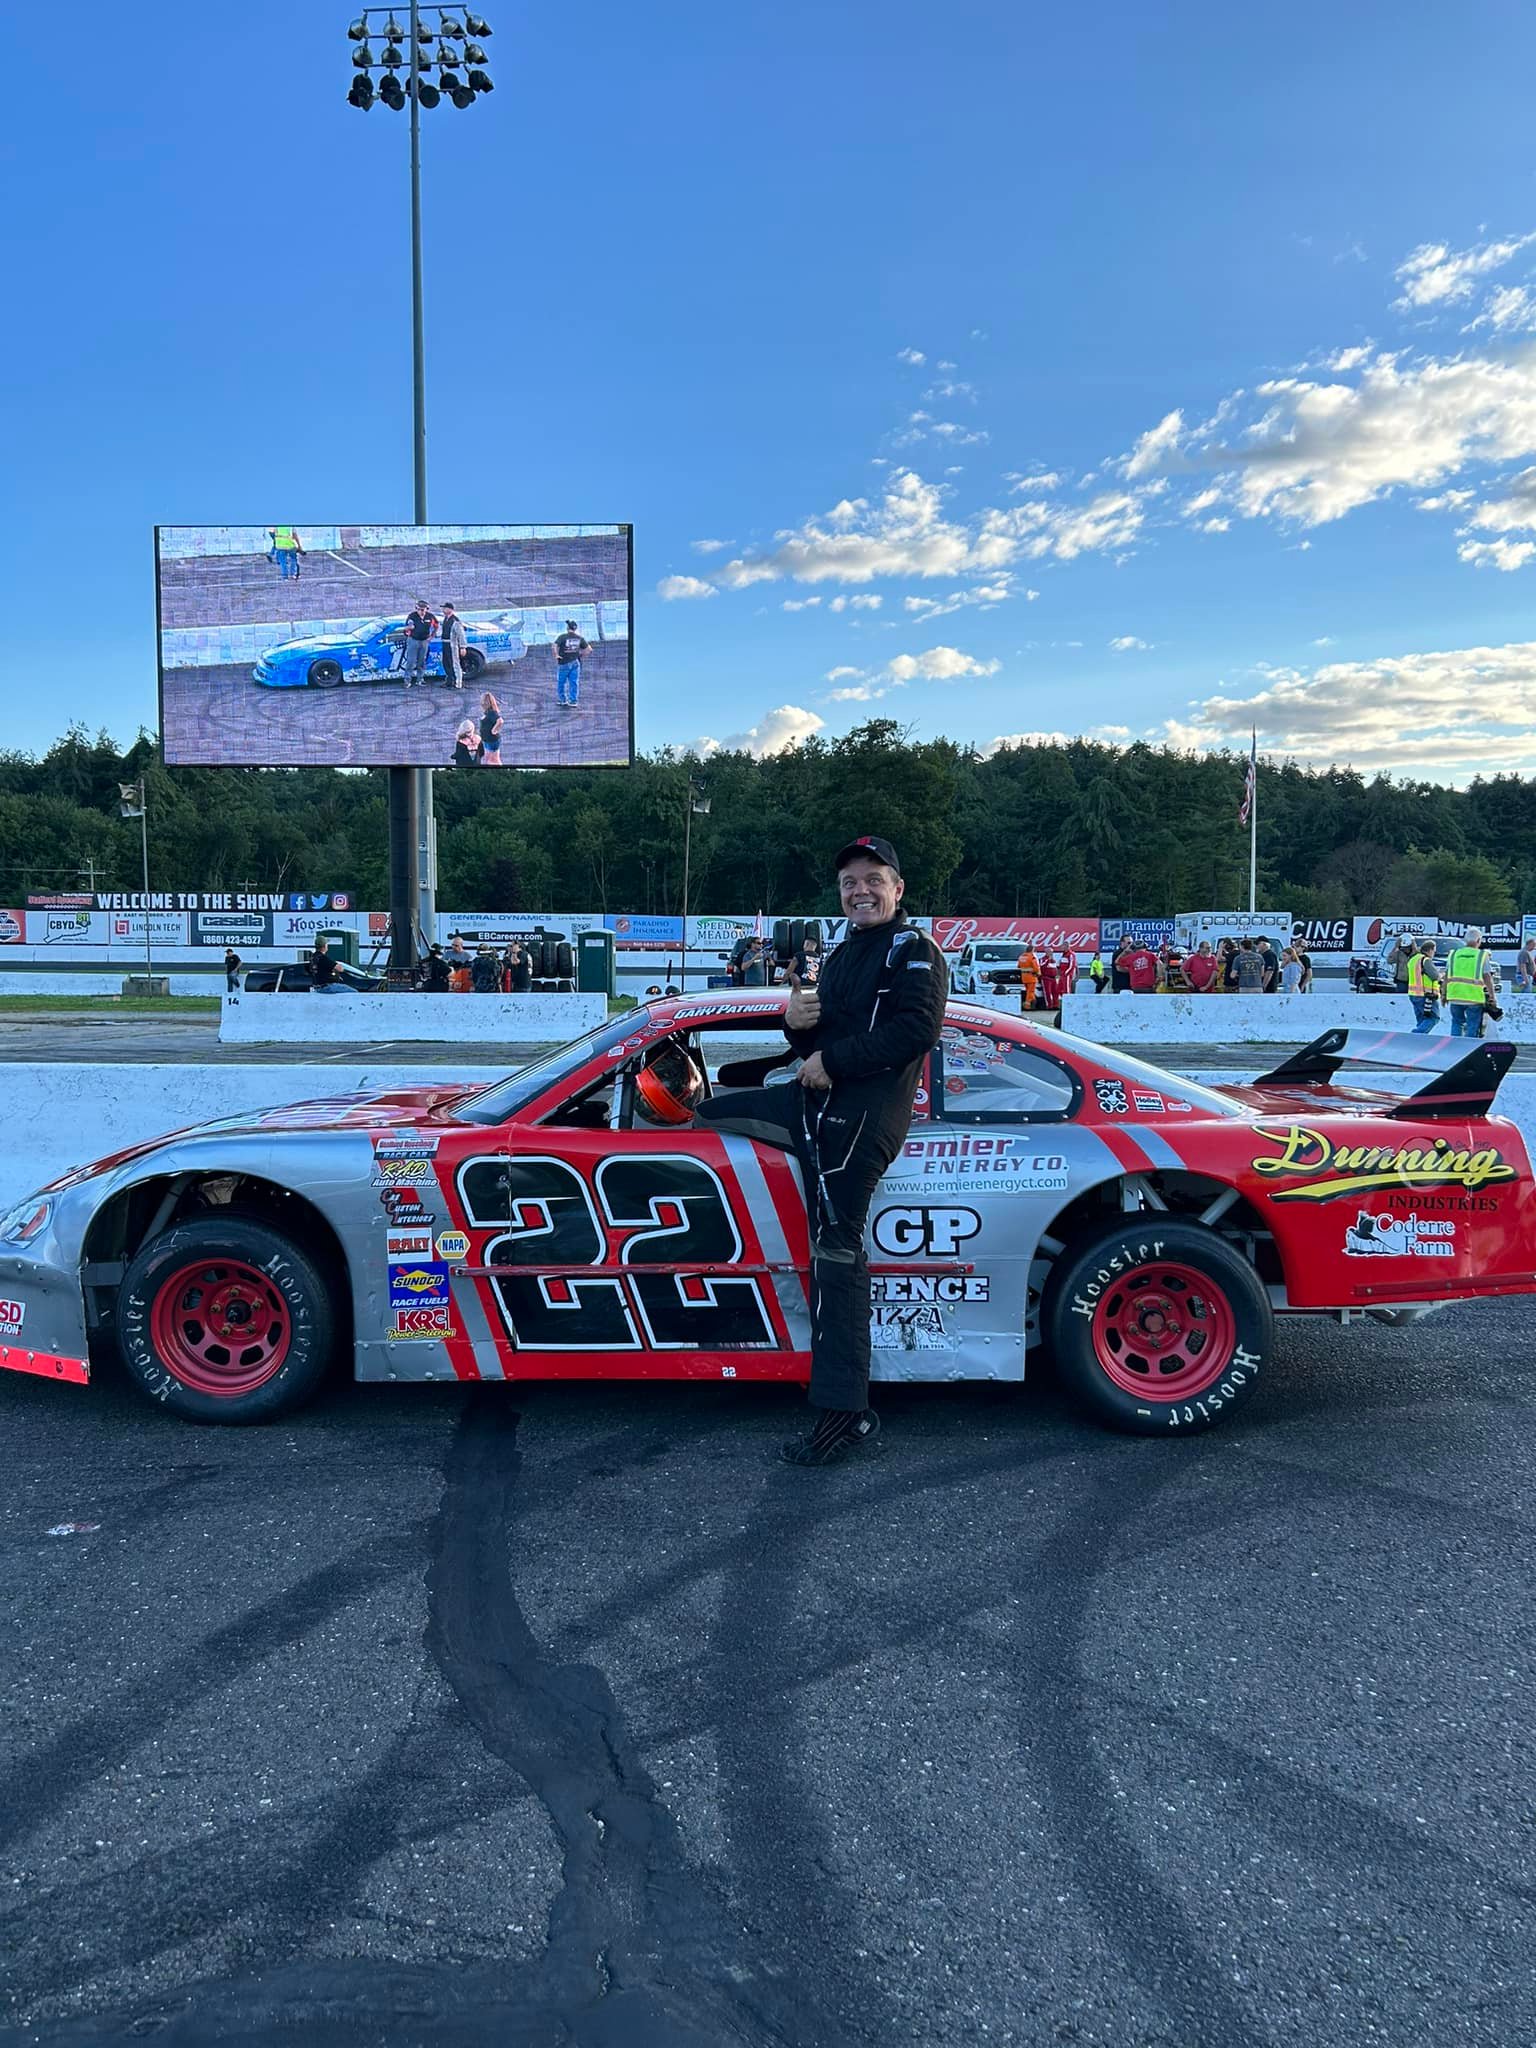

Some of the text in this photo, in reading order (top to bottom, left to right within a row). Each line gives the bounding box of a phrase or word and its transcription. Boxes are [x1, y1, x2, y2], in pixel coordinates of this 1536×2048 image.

[97, 893, 285, 910] WELCOME TO THE SHOW
[49, 920, 75, 930] CBYD
[132, 923, 161, 931] LINCOLN
[286, 916, 344, 933] Hoosier
[1124, 920, 1174, 931] Trantolo
[1292, 920, 1348, 940] CING
[1381, 922, 1425, 939] METRO
[478, 932, 542, 941] EBCareers.com
[935, 919, 1097, 949] Budweiser
[1132, 931, 1175, 941] Trantol
[1306, 940, 1345, 949] PARTNER
[902, 1135, 1011, 1157] emier
[923, 1156, 1069, 1174] ENERGY CO.
[1251, 1124, 1519, 1195] Dunning
[372, 1177, 438, 1187] Auto Machine
[885, 1176, 1067, 1194] www.premierenergyct.com
[1387, 1195, 1499, 1212] INDUSTRIES
[872, 1205, 982, 1257] GP
[1375, 1213, 1456, 1235] Coderre
[442, 1239, 465, 1251] NAPA
[455, 1153, 779, 1352] 22
[1404, 1236, 1455, 1256] Farm
[394, 1275, 443, 1287] SUNOCO
[870, 1276, 989, 1302] FENCE
[1071, 1240, 1165, 1322] Hoosier
[258, 1254, 314, 1363] Hoosier
[392, 1297, 449, 1307] RACE FUELS
[397, 1308, 448, 1332] KRC
[870, 1305, 947, 1336] IZZA
[126, 1289, 184, 1402] Hoosier
[721, 1366, 737, 1378] 22
[1168, 1343, 1262, 1427] Hoosier
